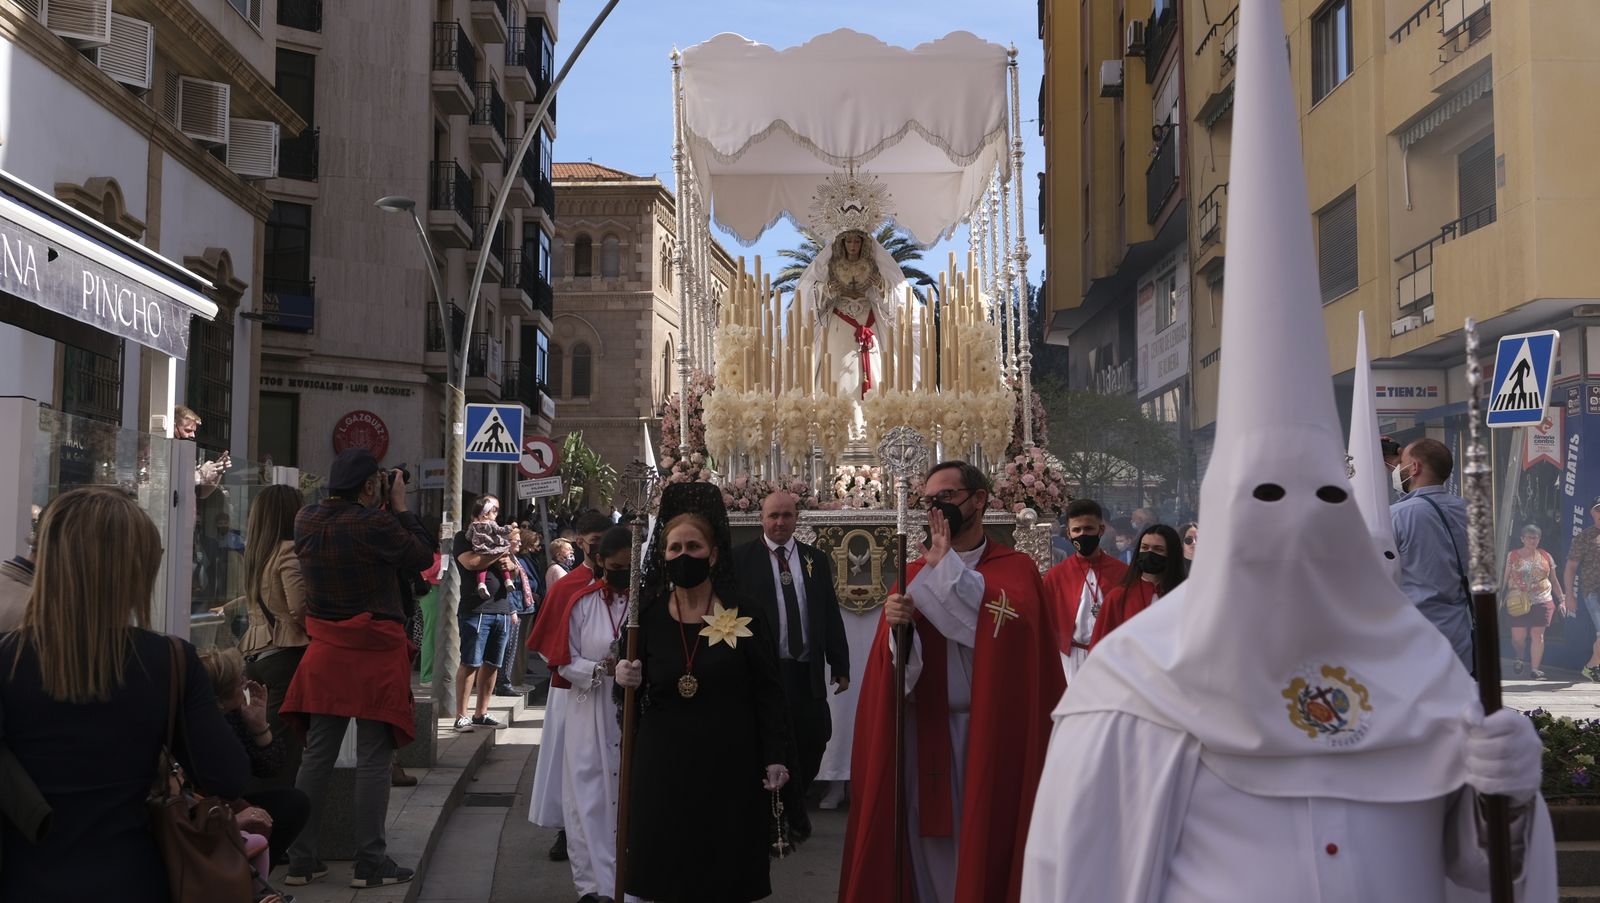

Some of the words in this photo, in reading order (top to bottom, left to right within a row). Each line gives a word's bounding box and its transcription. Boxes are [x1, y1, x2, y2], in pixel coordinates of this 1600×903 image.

[0, 233, 40, 291] NA
[82, 270, 162, 338] PINCHO
[288, 378, 343, 392] MUSICALES
[373, 385, 411, 397] GAZQUEZ
[1387, 386, 1414, 398] TIEN
[1415, 386, 1427, 398] 21
[1564, 433, 1580, 497] GRATIS
